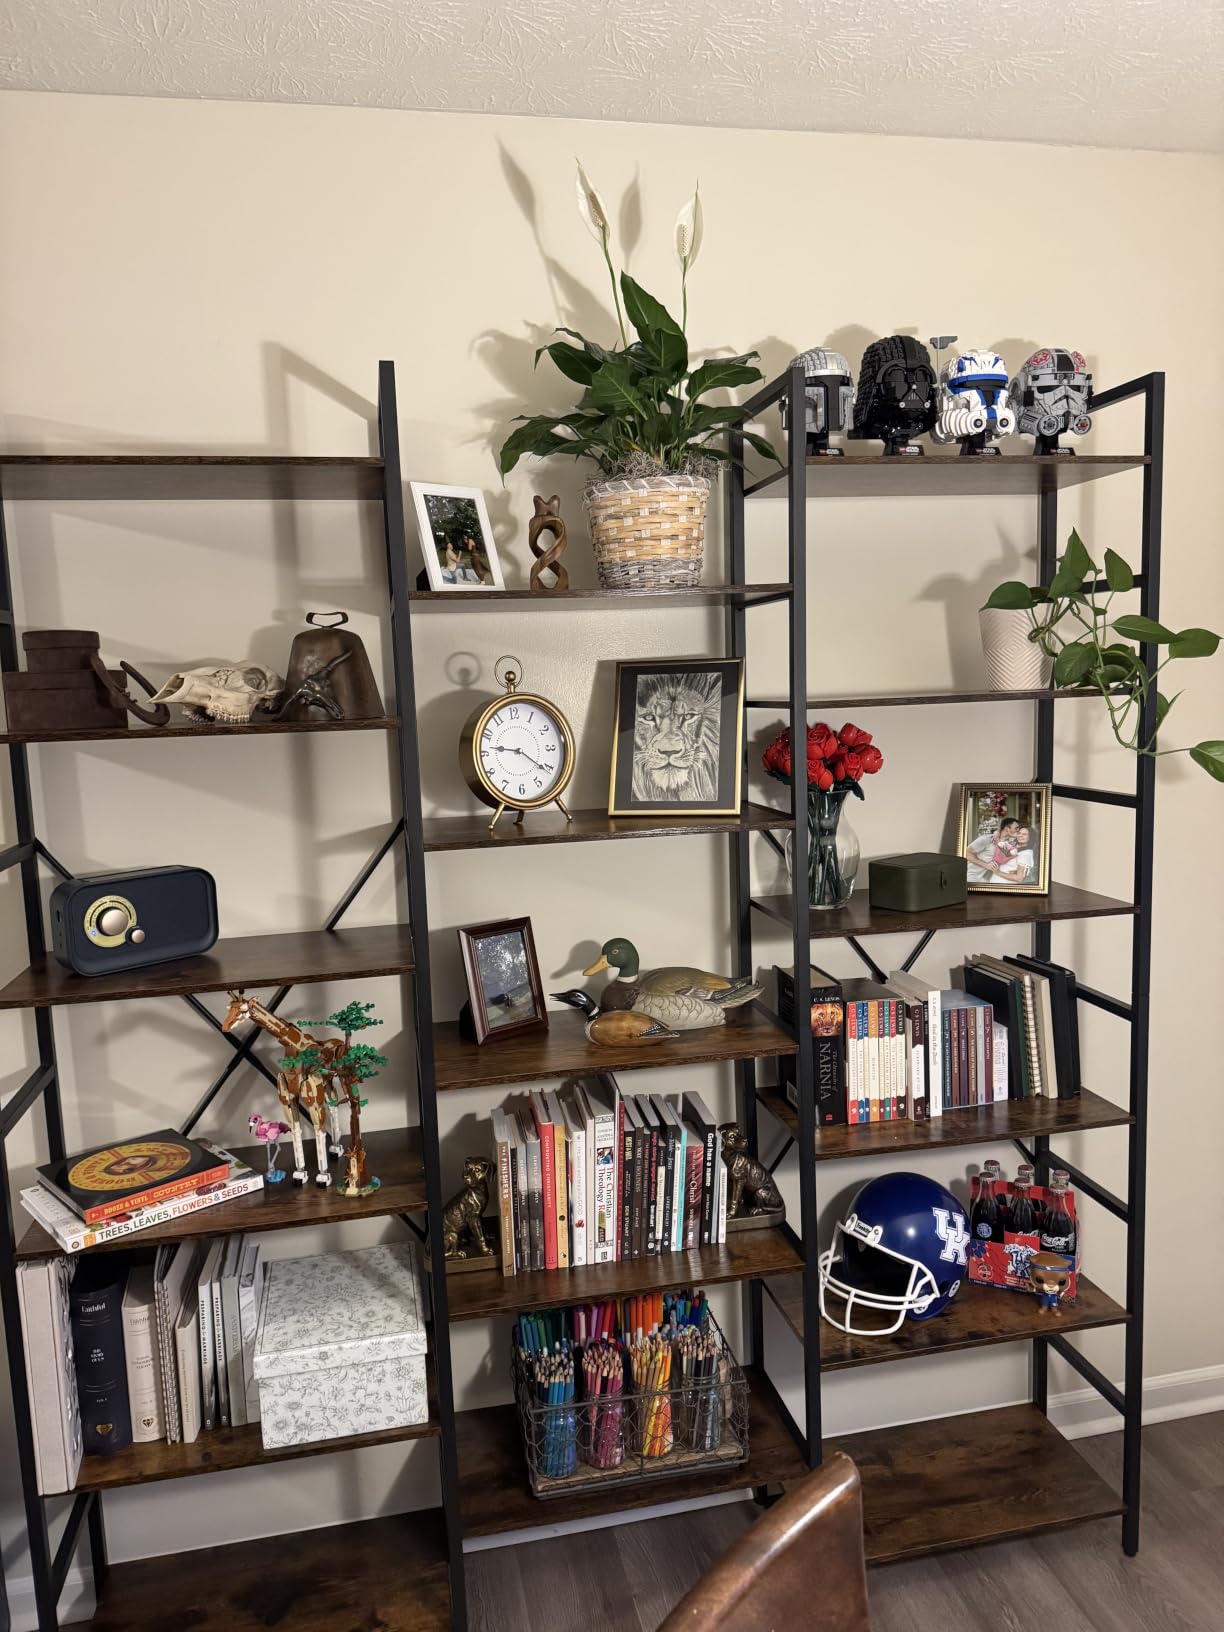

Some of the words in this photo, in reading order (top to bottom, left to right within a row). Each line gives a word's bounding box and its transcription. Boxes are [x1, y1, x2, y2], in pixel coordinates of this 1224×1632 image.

[492, 712, 504, 727] 11
[509, 706, 520, 720] 12
[526, 711, 534, 724] 1
[482, 727, 493, 742] 10
[538, 724, 549, 736] 2
[545, 744, 556, 752] 3
[486, 767, 496, 778] 8
[544, 762, 554, 772] 4
[501, 779, 510, 791] 7
[519, 783, 525, 795] 6
[533, 776, 543, 788] 5
[820, 1042, 831, 1101] NARNIA
[597, 1168, 605, 1202] Theology
[689, 1181, 697, 1203] Christ
[104, 1204, 123, 1214] BOOZE
[130, 1196, 148, 1206] VINYL
[154, 1178, 198, 1198] COUNTRY
[99, 1223, 132, 1240] TREES,
[134, 1210, 171, 1228] LEAVES,
[173, 1196, 212, 1215] FLOWERS
[214, 1193, 220, 1201] &
[222, 1184, 248, 1198] SEEDS
[932, 1206, 970, 1265] UK
